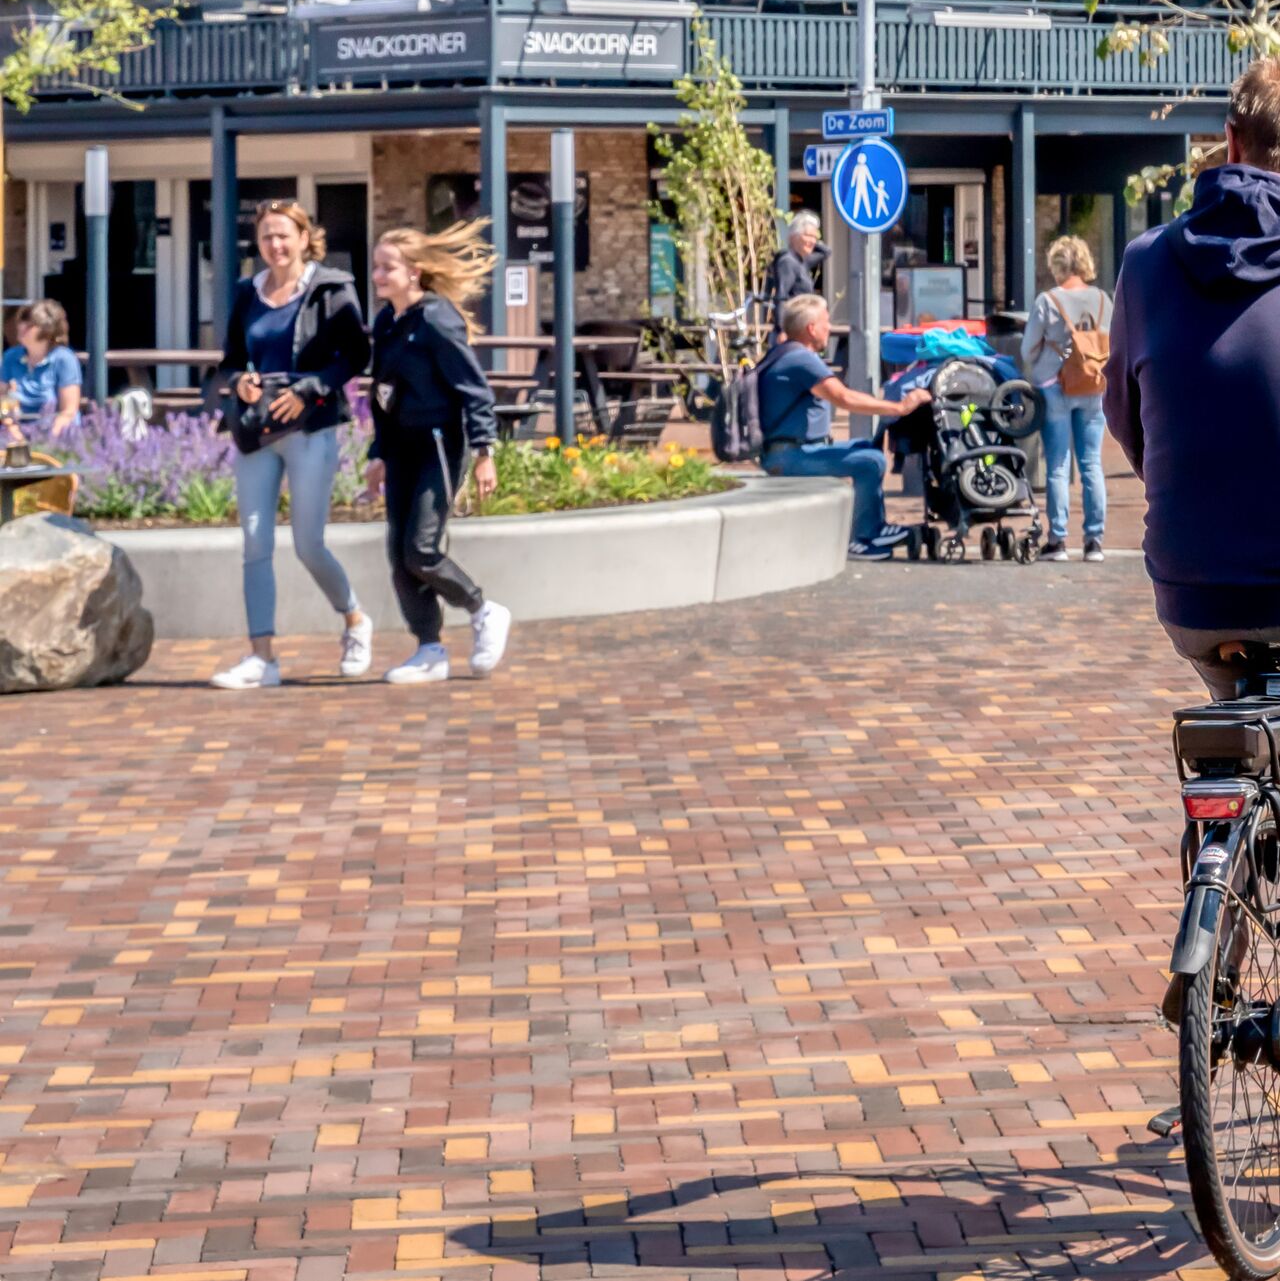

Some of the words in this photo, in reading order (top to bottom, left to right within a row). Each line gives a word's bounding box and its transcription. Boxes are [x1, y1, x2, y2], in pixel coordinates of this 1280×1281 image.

[336, 31, 467, 61] SNACKCORNER
[523, 31, 658, 57] SNACKCORNER
[827, 115, 845, 131] De
[849, 114, 886, 131] Zoom
